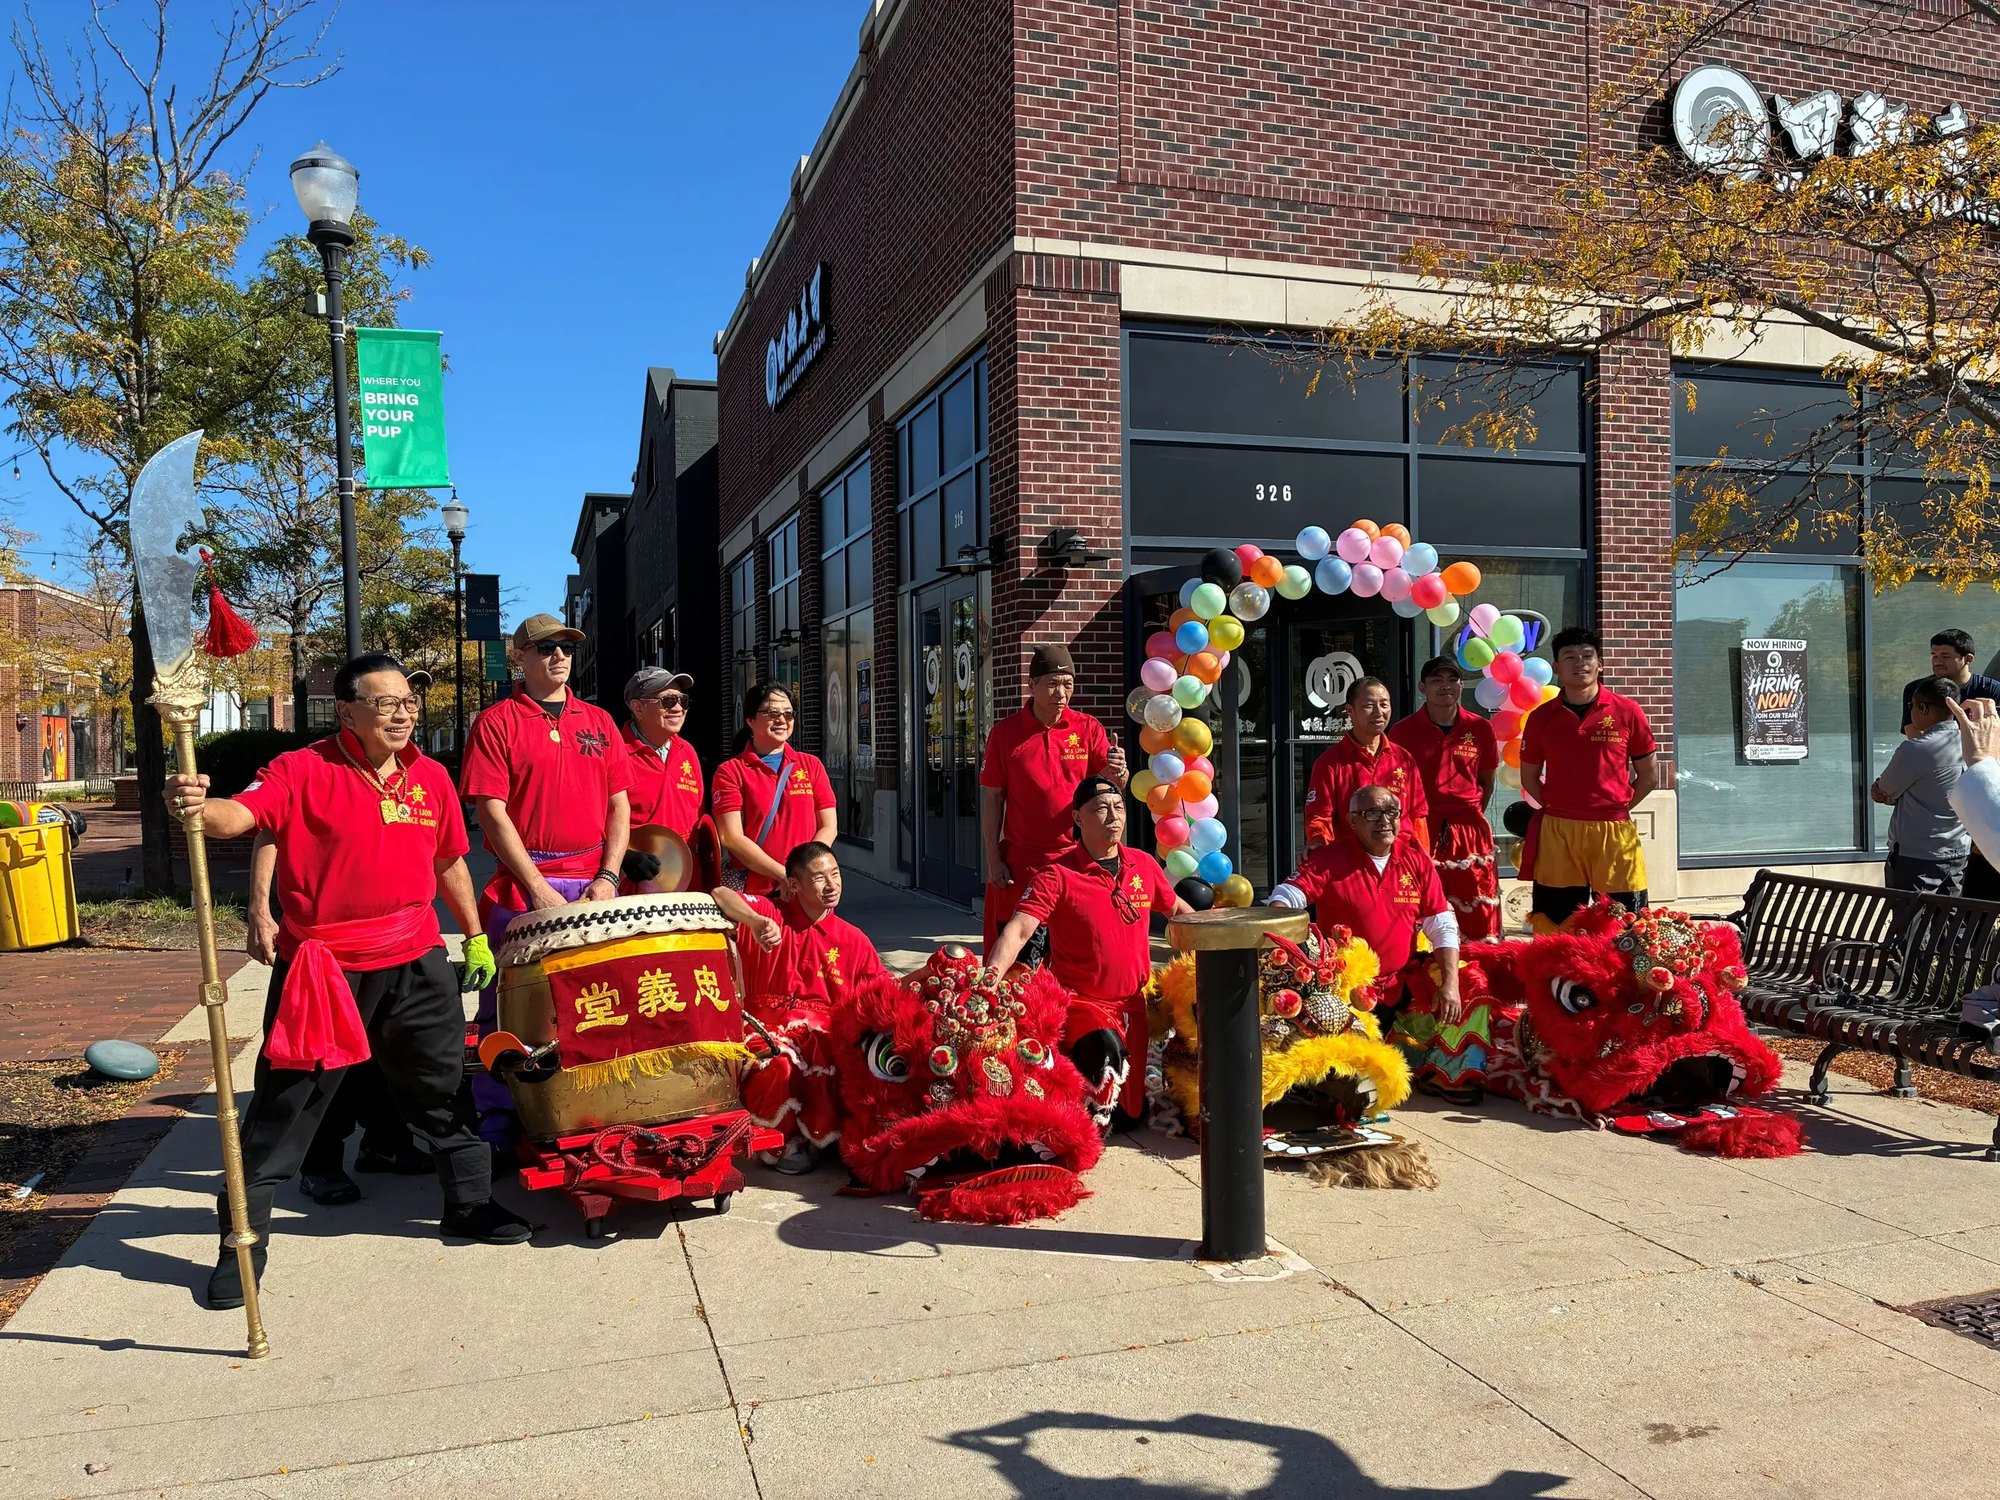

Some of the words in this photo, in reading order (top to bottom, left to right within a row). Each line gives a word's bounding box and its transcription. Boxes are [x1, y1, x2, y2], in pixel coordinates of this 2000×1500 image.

[363, 376, 398, 386] WHERE
[400, 378, 421, 387] YOU
[364, 392, 419, 406] BRING
[366, 409, 414, 422] YOUR
[366, 425, 402, 438] PUP
[1255, 483, 1292, 502] 326
[1747, 640, 1770, 649] NOW
[1772, 640, 1803, 649] HIRING
[1748, 673, 1802, 696] HIRING
[1757, 691, 1797, 711] NOW!
[419, 808, 433, 816] LION
[419, 818, 437, 828] GROUP
